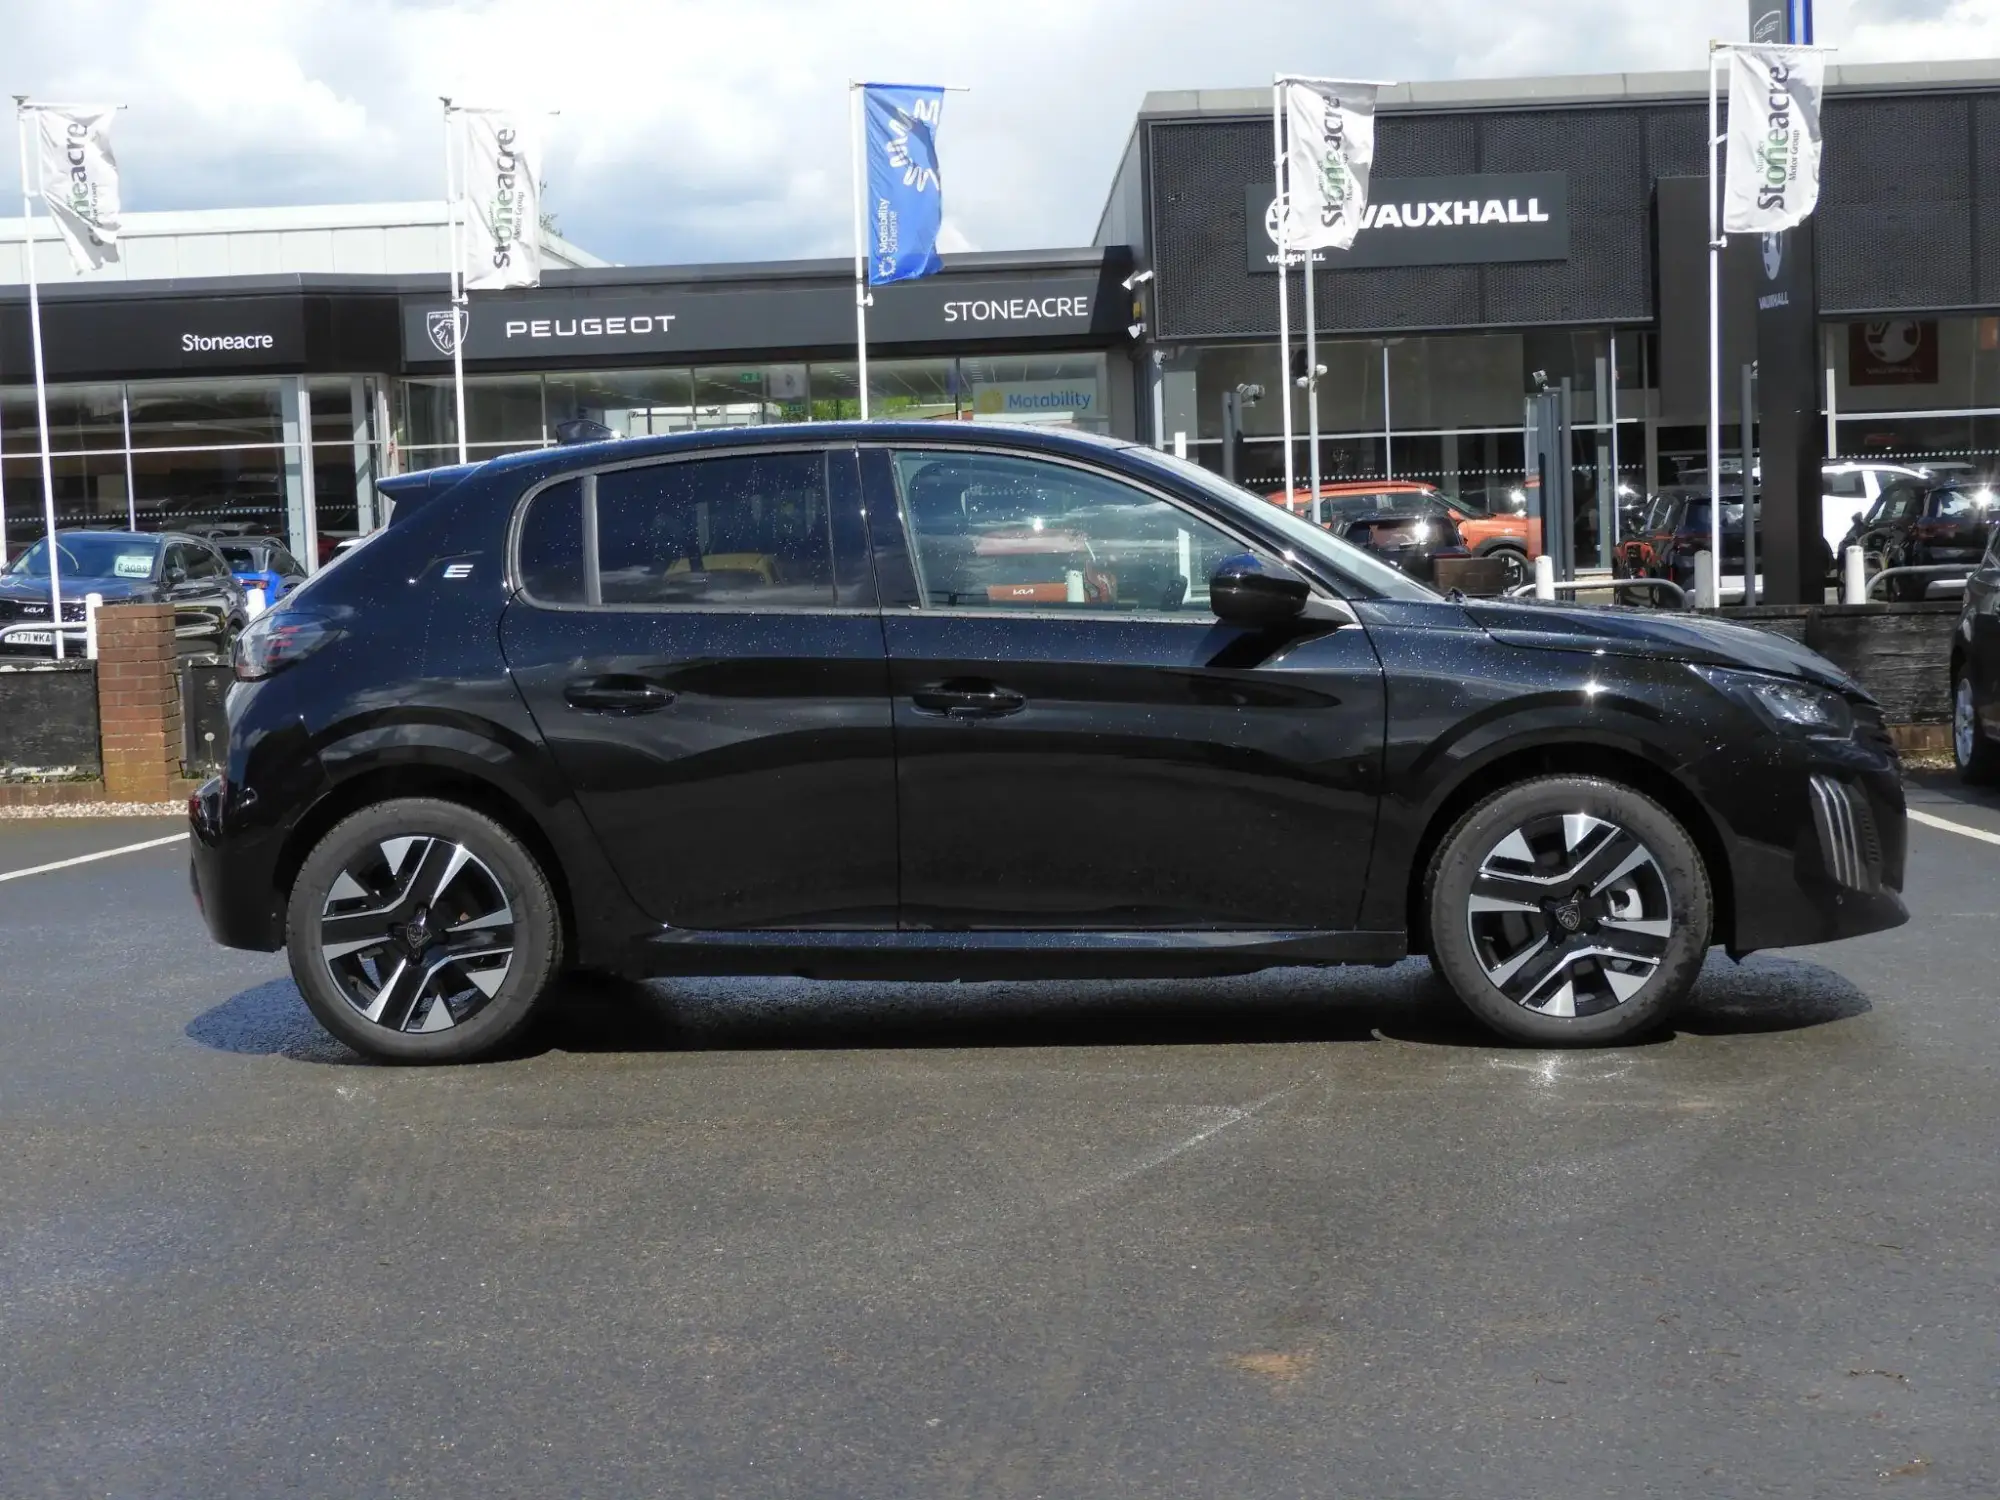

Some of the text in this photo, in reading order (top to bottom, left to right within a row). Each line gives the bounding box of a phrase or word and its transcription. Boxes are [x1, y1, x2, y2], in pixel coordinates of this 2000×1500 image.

[1757, 66, 1789, 211] Stoneacre
[1788, 129, 1800, 181] Motor Group
[878, 198, 891, 253] Motability
[888, 211, 898, 253] Scheme
[1266, 253, 1326, 264] VAXHLL
[943, 297, 1089, 322] STONEACRE
[506, 315, 676, 338] PEUGEOT
[182, 333, 273, 352] Stoneacre
[1008, 388, 1092, 410] Motability
